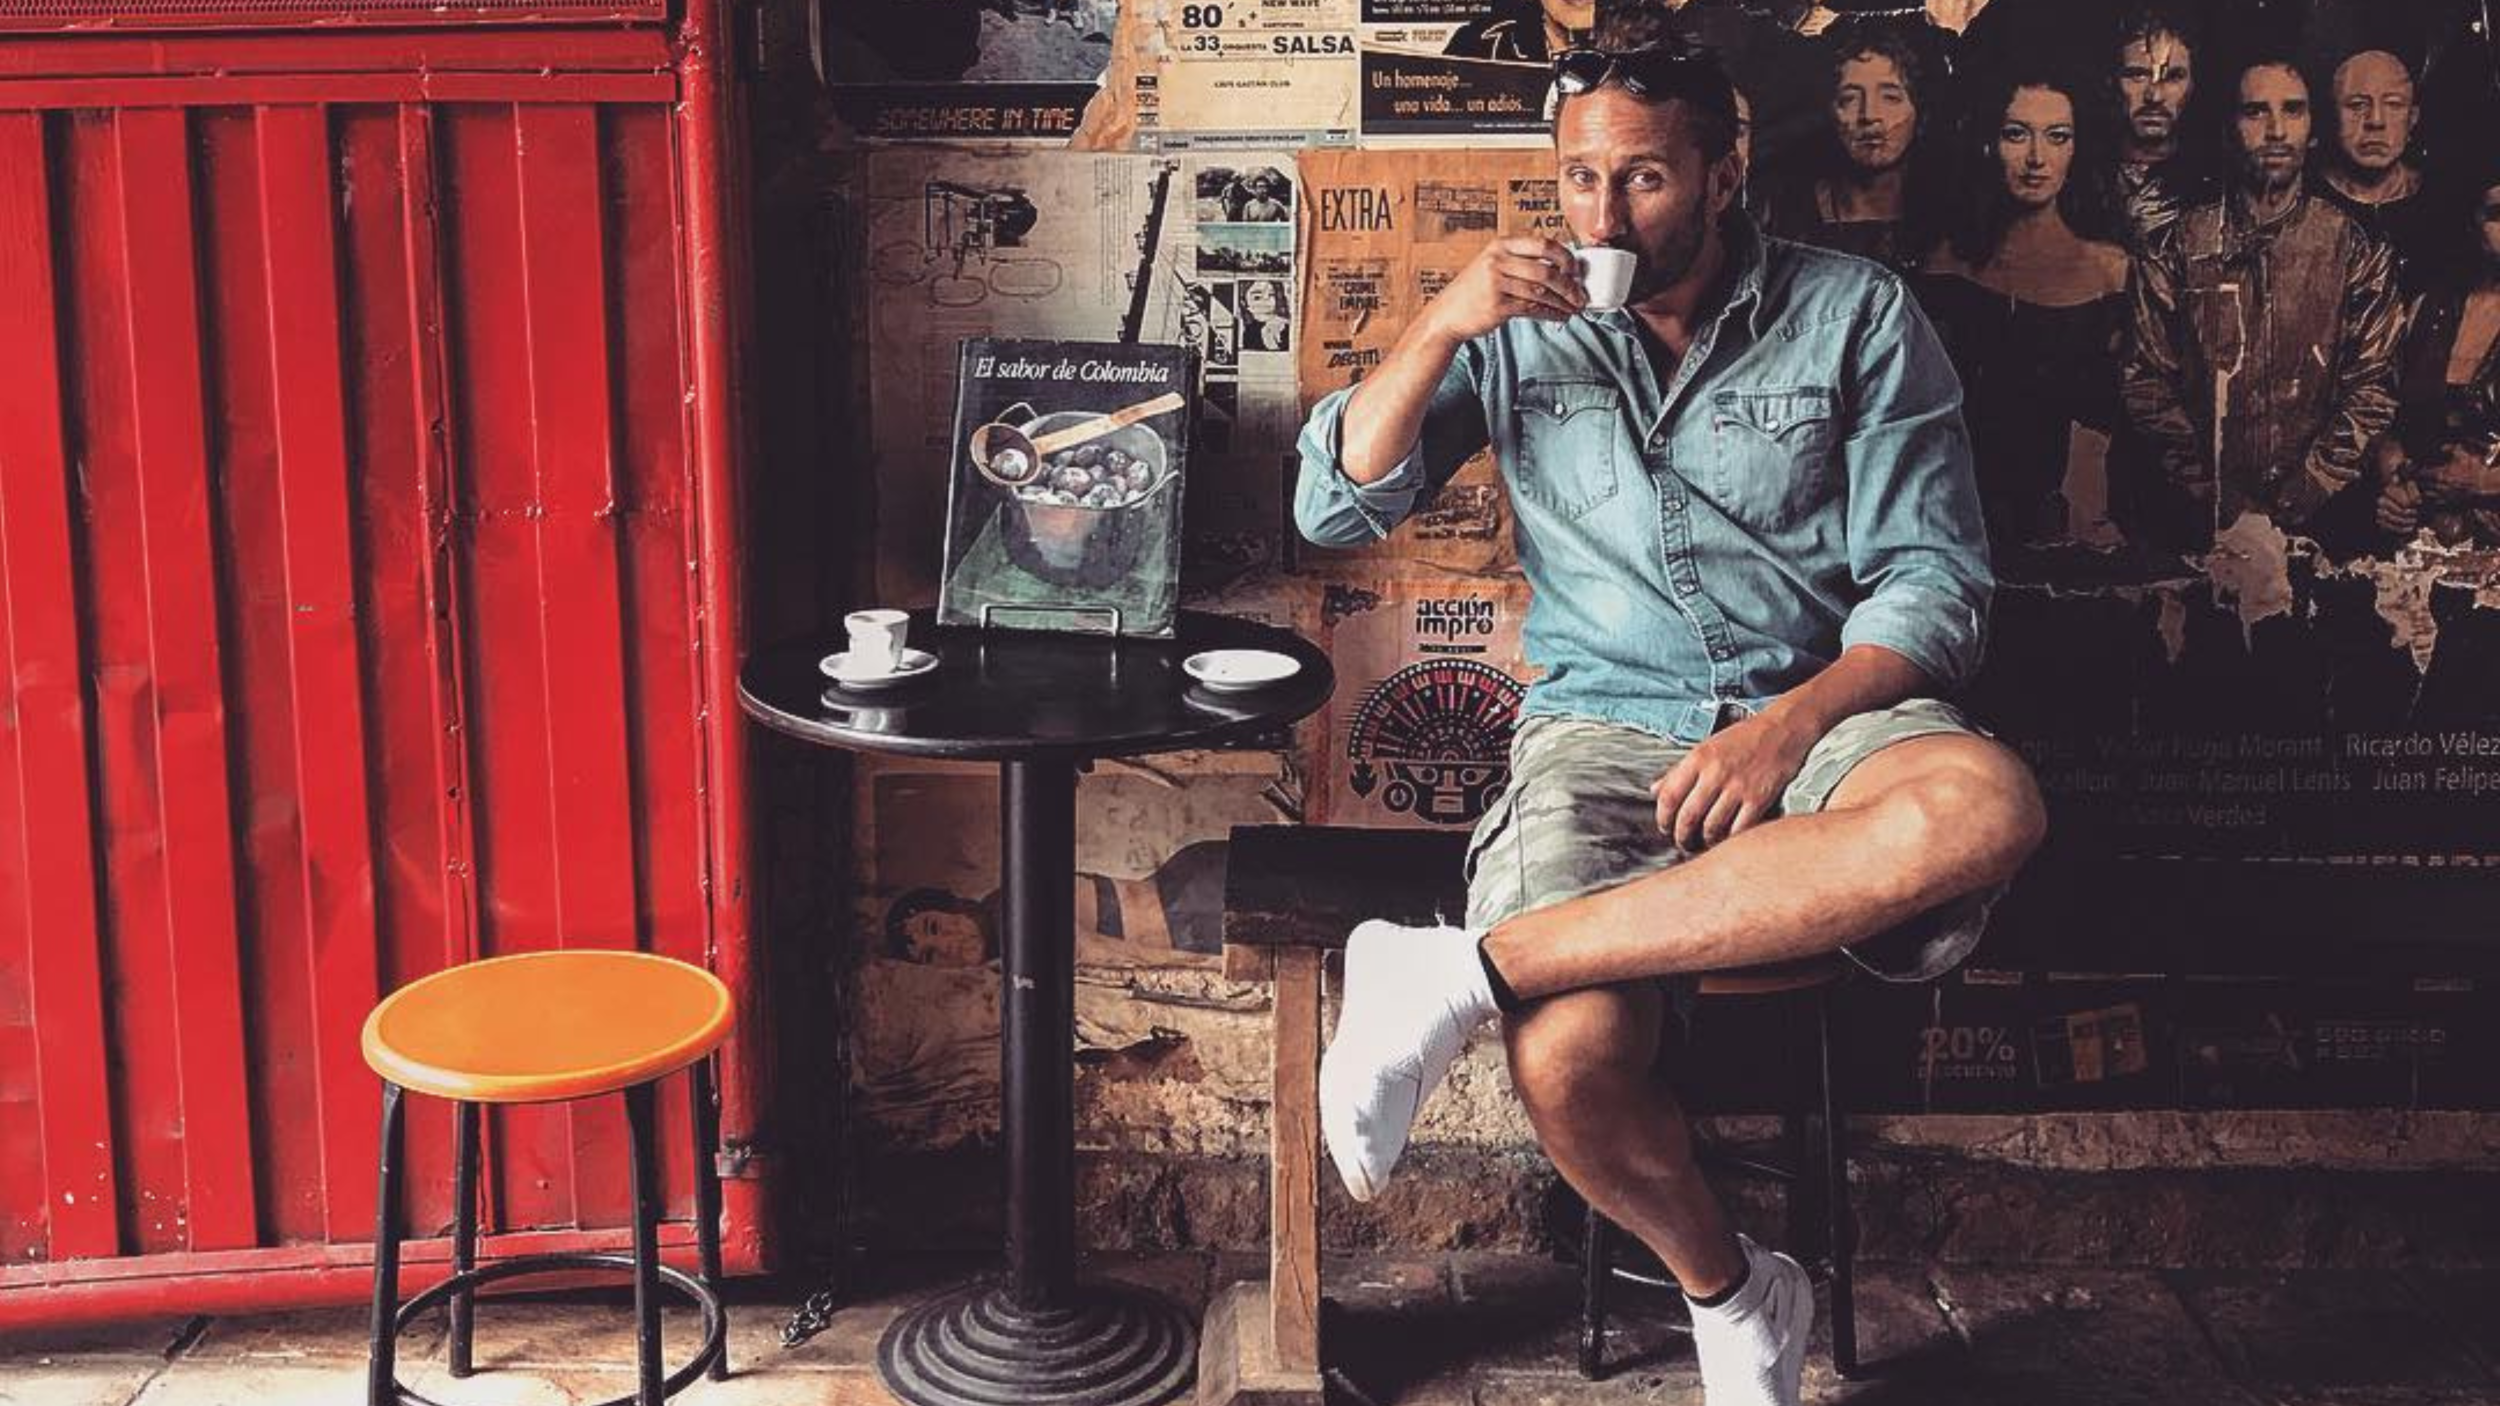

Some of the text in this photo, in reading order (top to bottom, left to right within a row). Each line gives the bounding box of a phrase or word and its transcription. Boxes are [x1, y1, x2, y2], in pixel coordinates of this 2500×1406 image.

[1194, 36, 1220, 51] 33
[1273, 35, 1355, 54] SALSA
[1372, 71, 1392, 89] Un
[877, 106, 1076, 131] SOMEWHERE IN TIME
[1394, 100, 1420, 113] una
[1467, 100, 1486, 112] un
[1321, 188, 1394, 232] EXTRA
[974, 356, 1170, 384] El sabor de Colombia
[1416, 592, 1494, 618] acción
[1416, 617, 1494, 642] impro
[2346, 730, 2433, 758] Ricardo
[2439, 730, 2500, 757] Vélez
[2198, 767, 2284, 793] Manuel
[2372, 766, 2427, 792] Juan
[2434, 765, 2500, 797] Felipe
[1918, 1026, 2016, 1062] 20%
